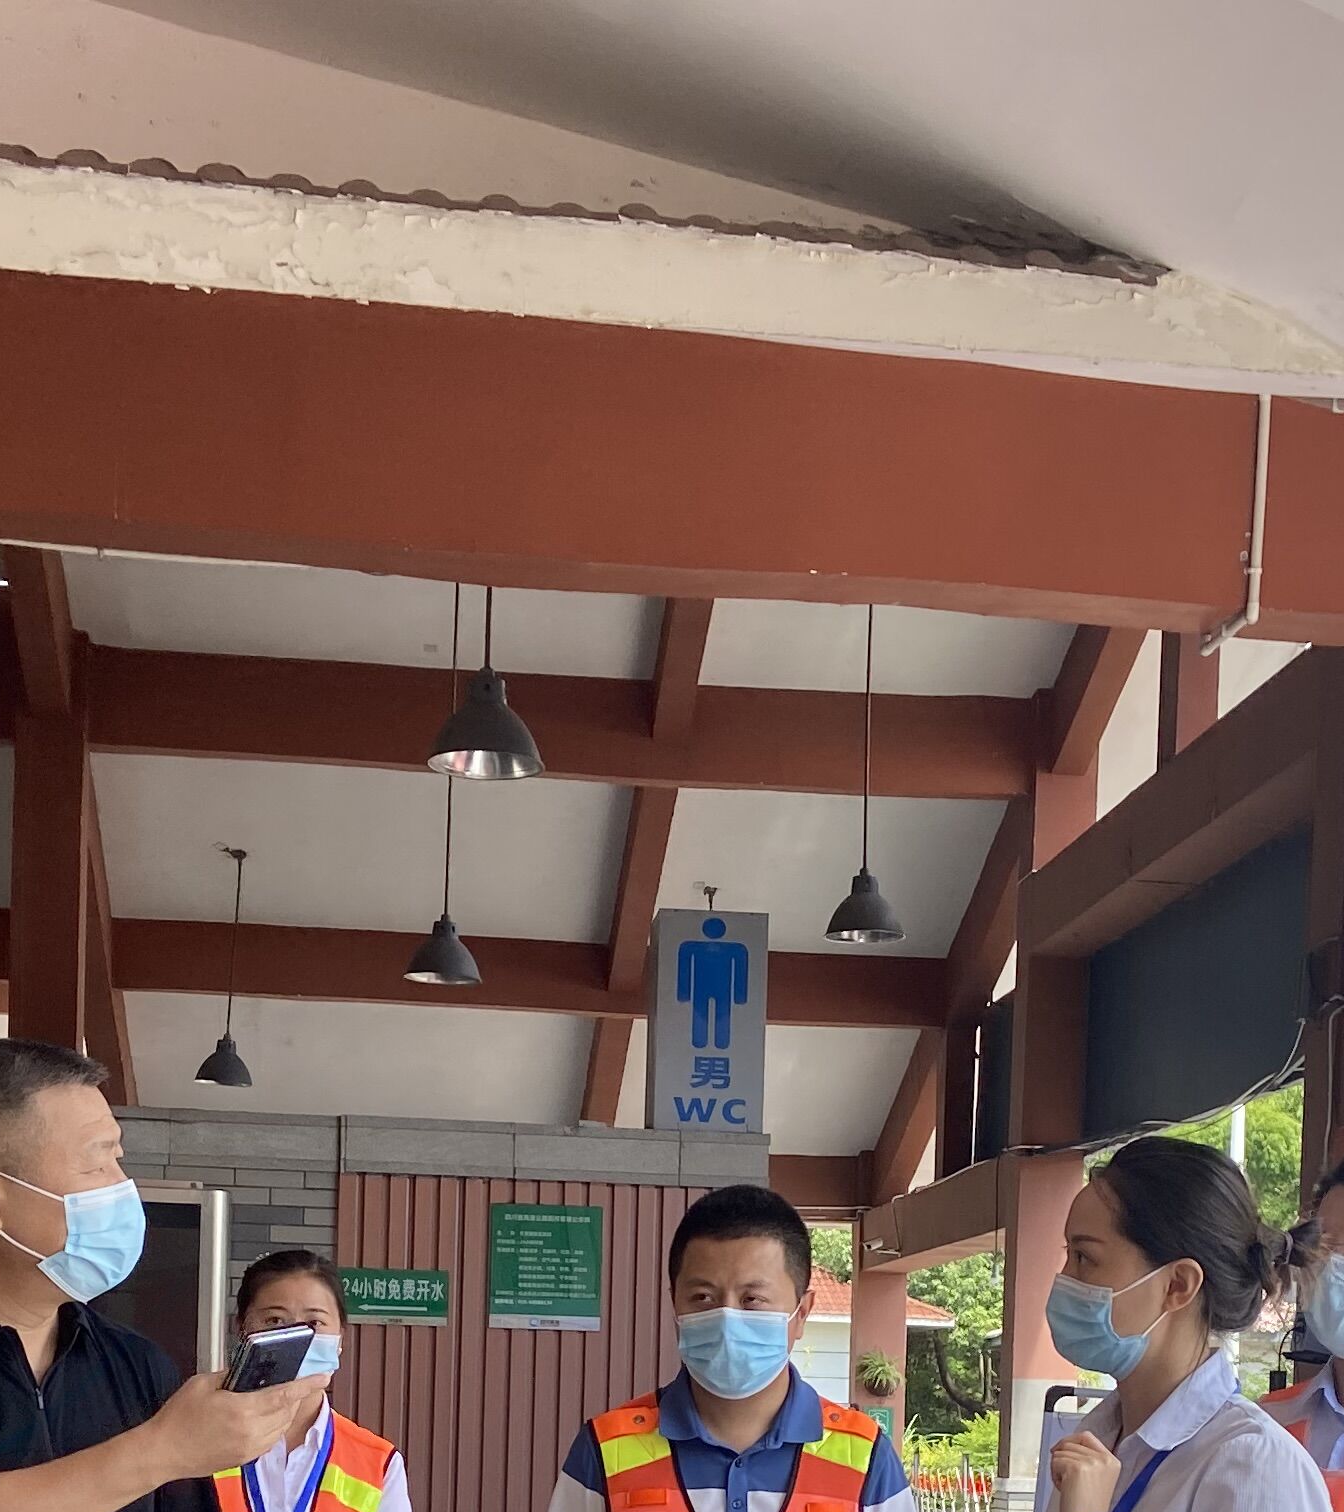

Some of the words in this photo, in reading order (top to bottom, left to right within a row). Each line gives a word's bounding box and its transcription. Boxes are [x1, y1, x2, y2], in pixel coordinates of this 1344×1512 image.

[690, 1056, 731, 1089] 男
[673, 1097, 746, 1124] WC
[342, 1277, 445, 1302] 24小时免费开水
